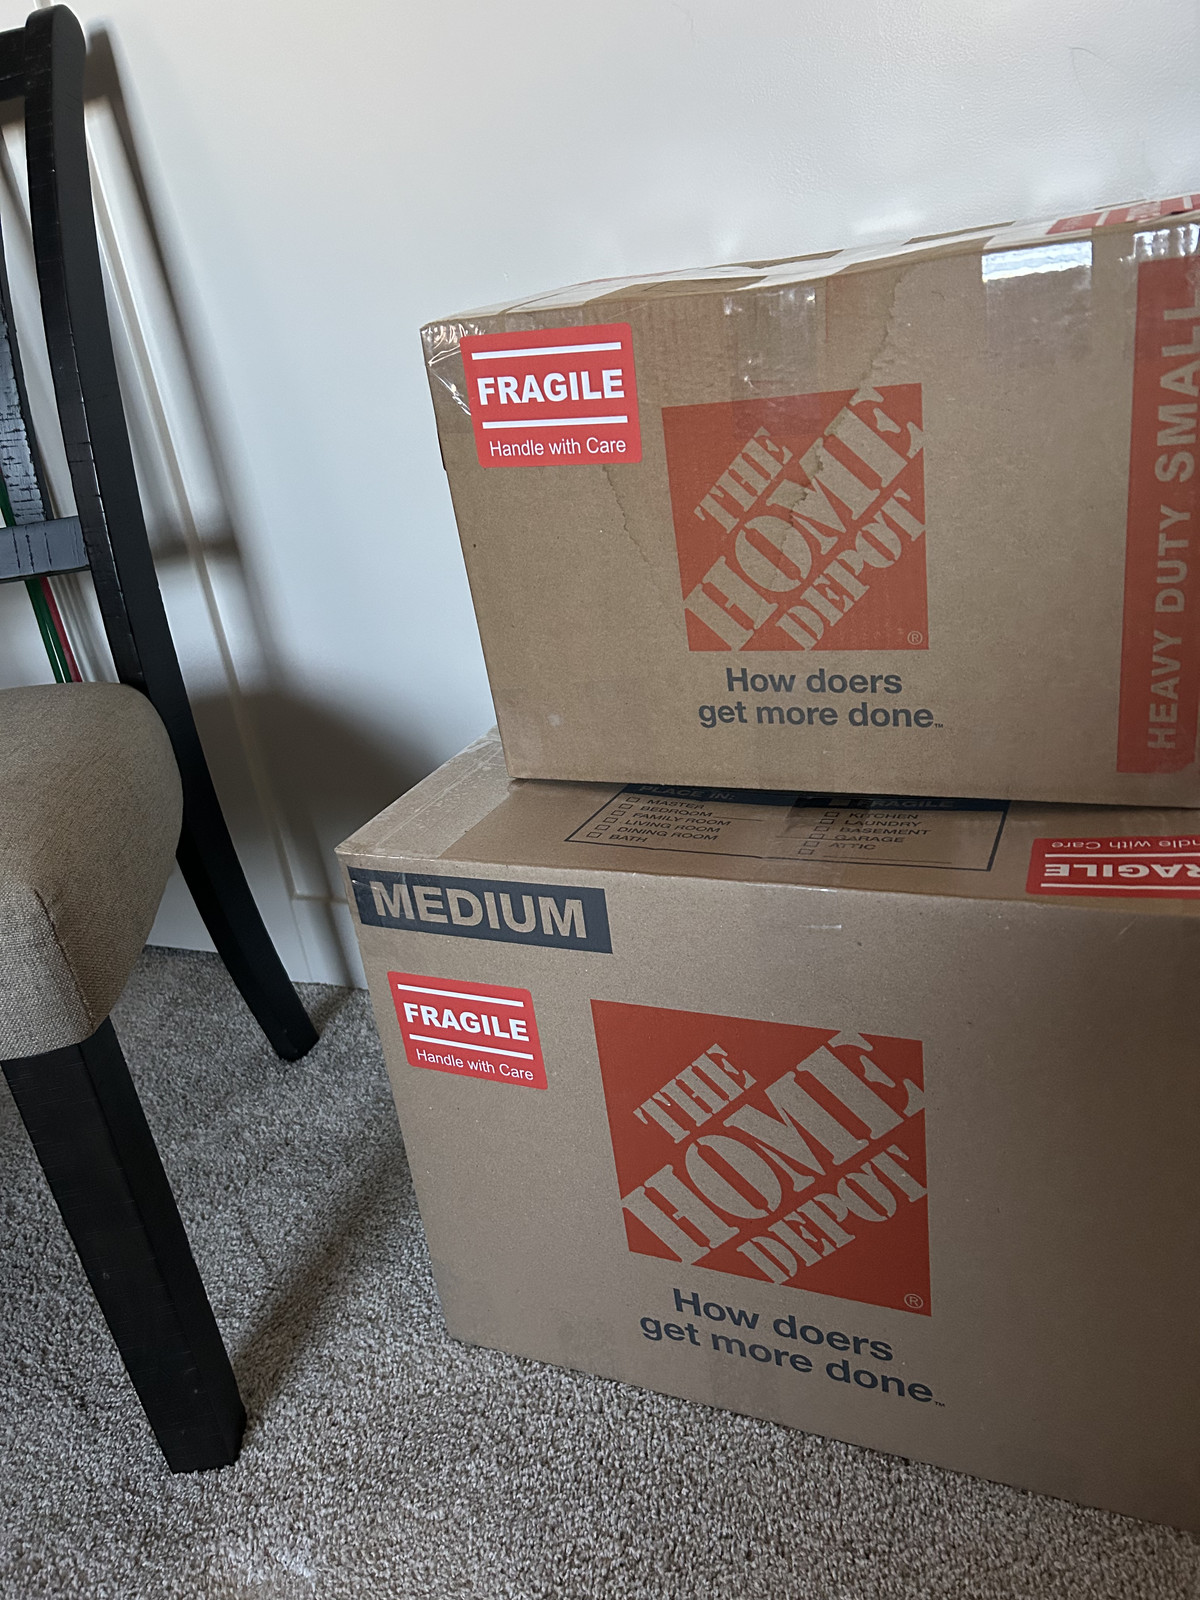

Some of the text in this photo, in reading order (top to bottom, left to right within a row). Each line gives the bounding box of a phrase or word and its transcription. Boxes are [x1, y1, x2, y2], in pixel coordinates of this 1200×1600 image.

[476, 368, 625, 406] FRAGILE
[489, 436, 627, 457] Handle with Care
[693, 425, 794, 535] THE
[683, 386, 925, 651] HOME
[1147, 288, 1200, 750] HEAVY DUTY SMALL
[774, 487, 926, 651] DEPOT
[725, 667, 903, 694] How doers
[698, 702, 748, 729] get
[756, 705, 839, 726] more
[638, 785, 704, 799] PLACE
[639, 805, 713, 818] BEDROOM
[647, 799, 706, 810] MASTER
[856, 798, 955, 808] FRAGILE
[624, 819, 721, 834] LIVING ROOM
[632, 812, 732, 827] FAMILY ROOM
[844, 819, 923, 828] LAUNDRY
[849, 812, 919, 820] KITCHEN
[608, 834, 649, 843] BATH
[616, 826, 719, 842] DINING ROOM
[834, 834, 906, 844] GARAGE
[839, 826, 932, 836] BASEMENT
[828, 842, 876, 851] ATTIC
[1051, 841, 1101, 850] Care
[1109, 839, 1151, 850] with
[369, 880, 588, 940] MEDIUM
[402, 1002, 531, 1043] FRAGILE
[416, 1048, 534, 1081] Handle with Care
[632, 1042, 757, 1144] THE
[621, 1028, 925, 1266] HOME
[736, 1143, 928, 1286] DEPOT
[672, 1287, 894, 1362] How doers
[639, 1315, 701, 1347] get
[711, 1332, 813, 1374] more
